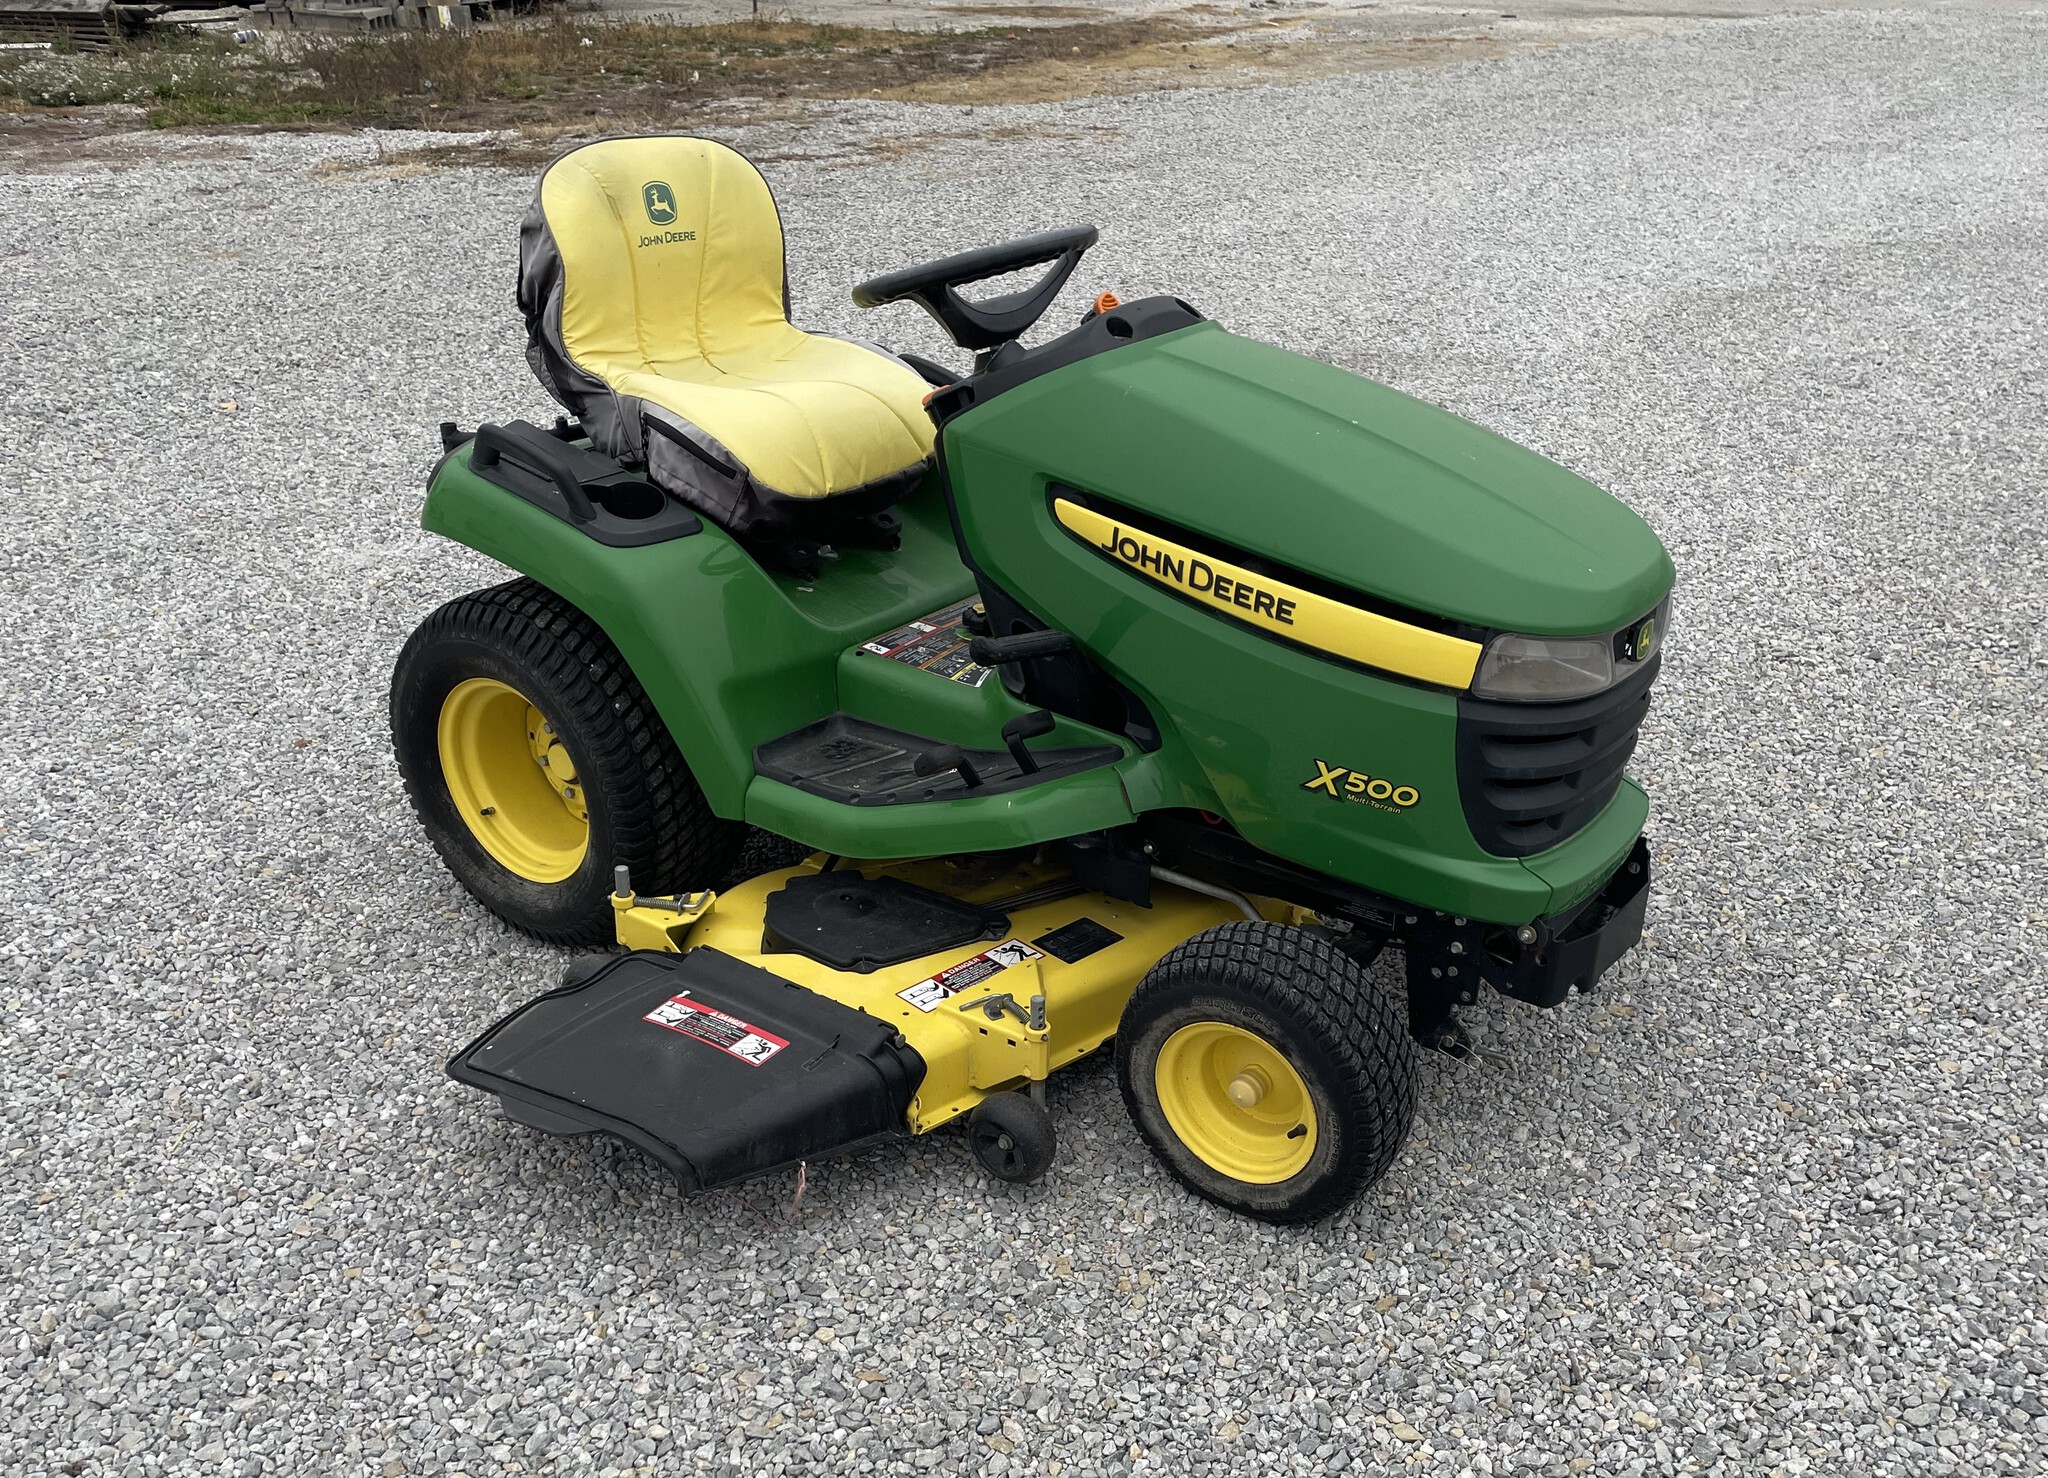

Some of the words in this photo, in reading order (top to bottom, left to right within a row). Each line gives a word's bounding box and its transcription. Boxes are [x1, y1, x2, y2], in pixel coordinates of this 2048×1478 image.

[638, 234, 664, 248] JOHN
[664, 231, 696, 244] DEERE
[1101, 526, 1184, 583] JOHN
[1188, 558, 1297, 626] DEERE
[1301, 758, 1420, 807] X500
[1346, 793, 1401, 814] Multi-Terrain
[948, 958, 981, 973] DANGER
[717, 1013, 748, 1028] DANGER
[1191, 995, 1280, 1032] CARLISLE
